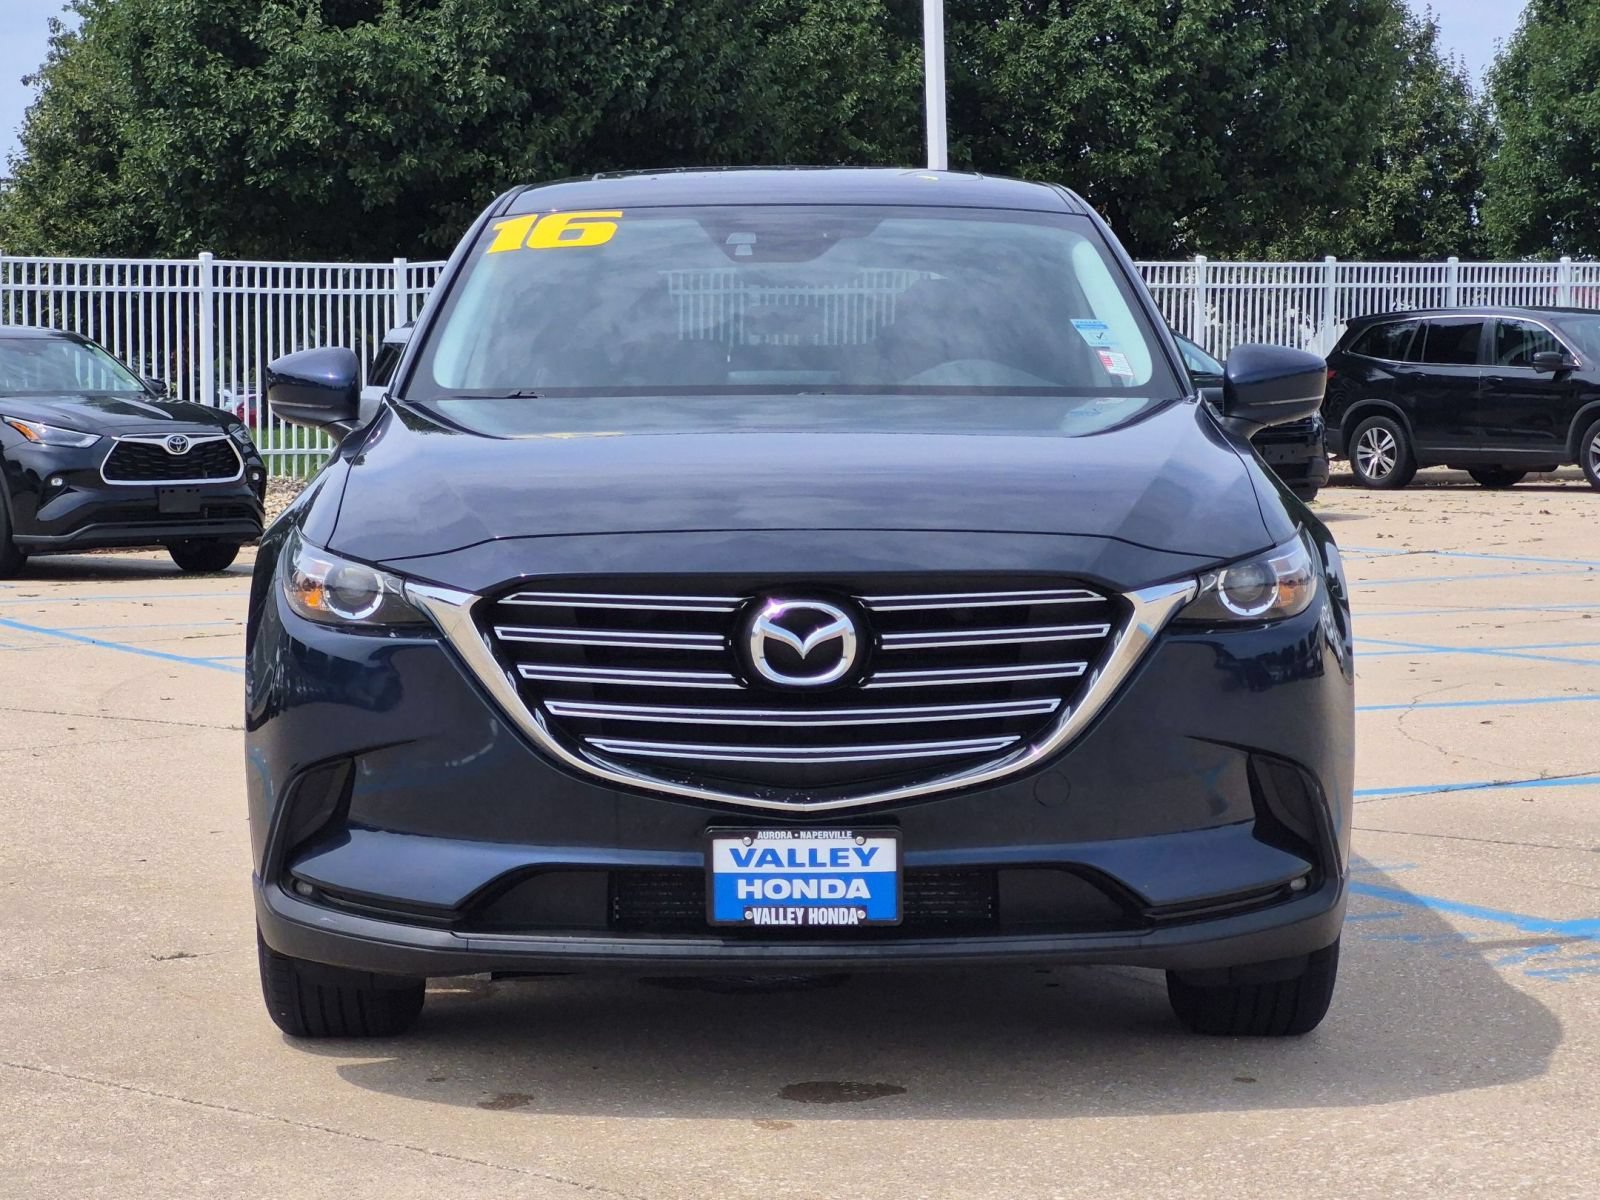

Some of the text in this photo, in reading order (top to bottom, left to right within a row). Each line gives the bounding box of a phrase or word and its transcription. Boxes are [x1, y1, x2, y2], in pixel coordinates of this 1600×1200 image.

[486, 210, 624, 254] 16
[757, 831, 853, 840] AURORA NAPERVILLE
[729, 847, 880, 868] VALLEY
[737, 878, 871, 900] HONDA
[752, 907, 859, 925] VALLEY HONDA
